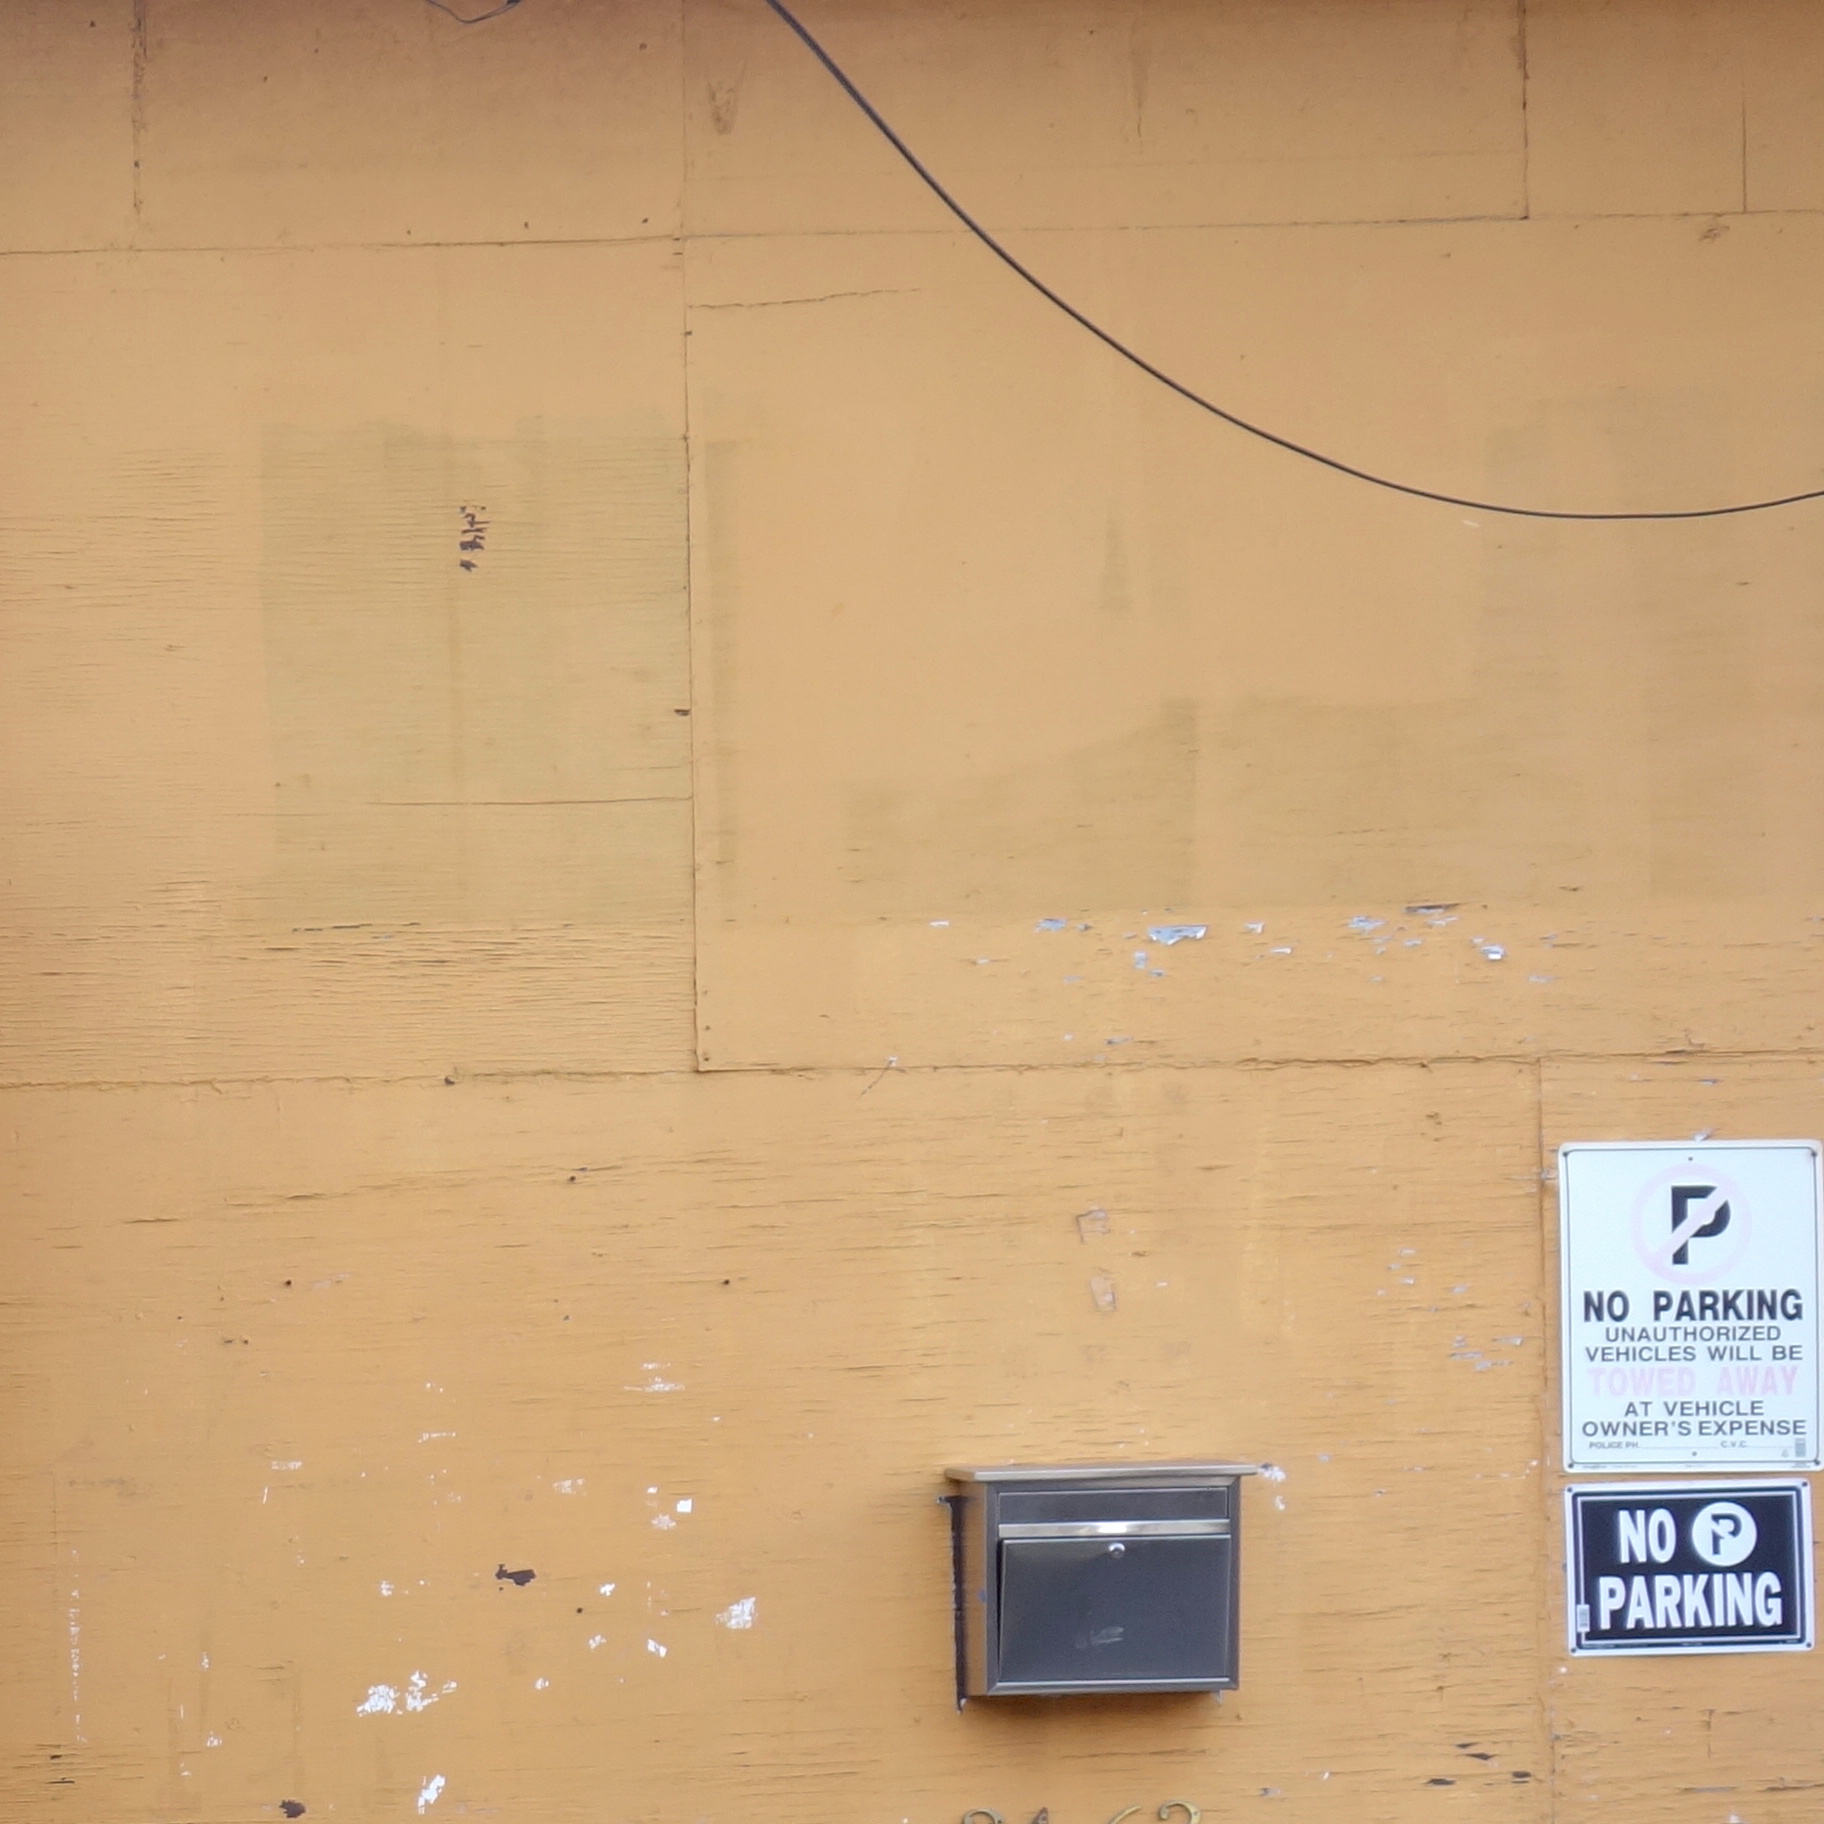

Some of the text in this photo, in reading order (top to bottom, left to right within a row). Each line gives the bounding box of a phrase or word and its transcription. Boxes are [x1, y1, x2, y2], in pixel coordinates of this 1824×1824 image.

[1583, 1288, 1804, 1322] NO PARKING
[1604, 1325, 1781, 1342] UNAUTHORIZED
[1585, 1344, 1803, 1362] VEHICLES WILL BE
[1587, 1365, 1799, 1398] TOWED AWAY
[1624, 1400, 1764, 1417] AT VEHICLE
[1581, 1419, 1808, 1438] OWNER'S EXPENSE
[1589, 1441, 1623, 1449] POLICE
[1619, 1508, 1677, 1563] NO
[1599, 1571, 1783, 1630] PARKING
